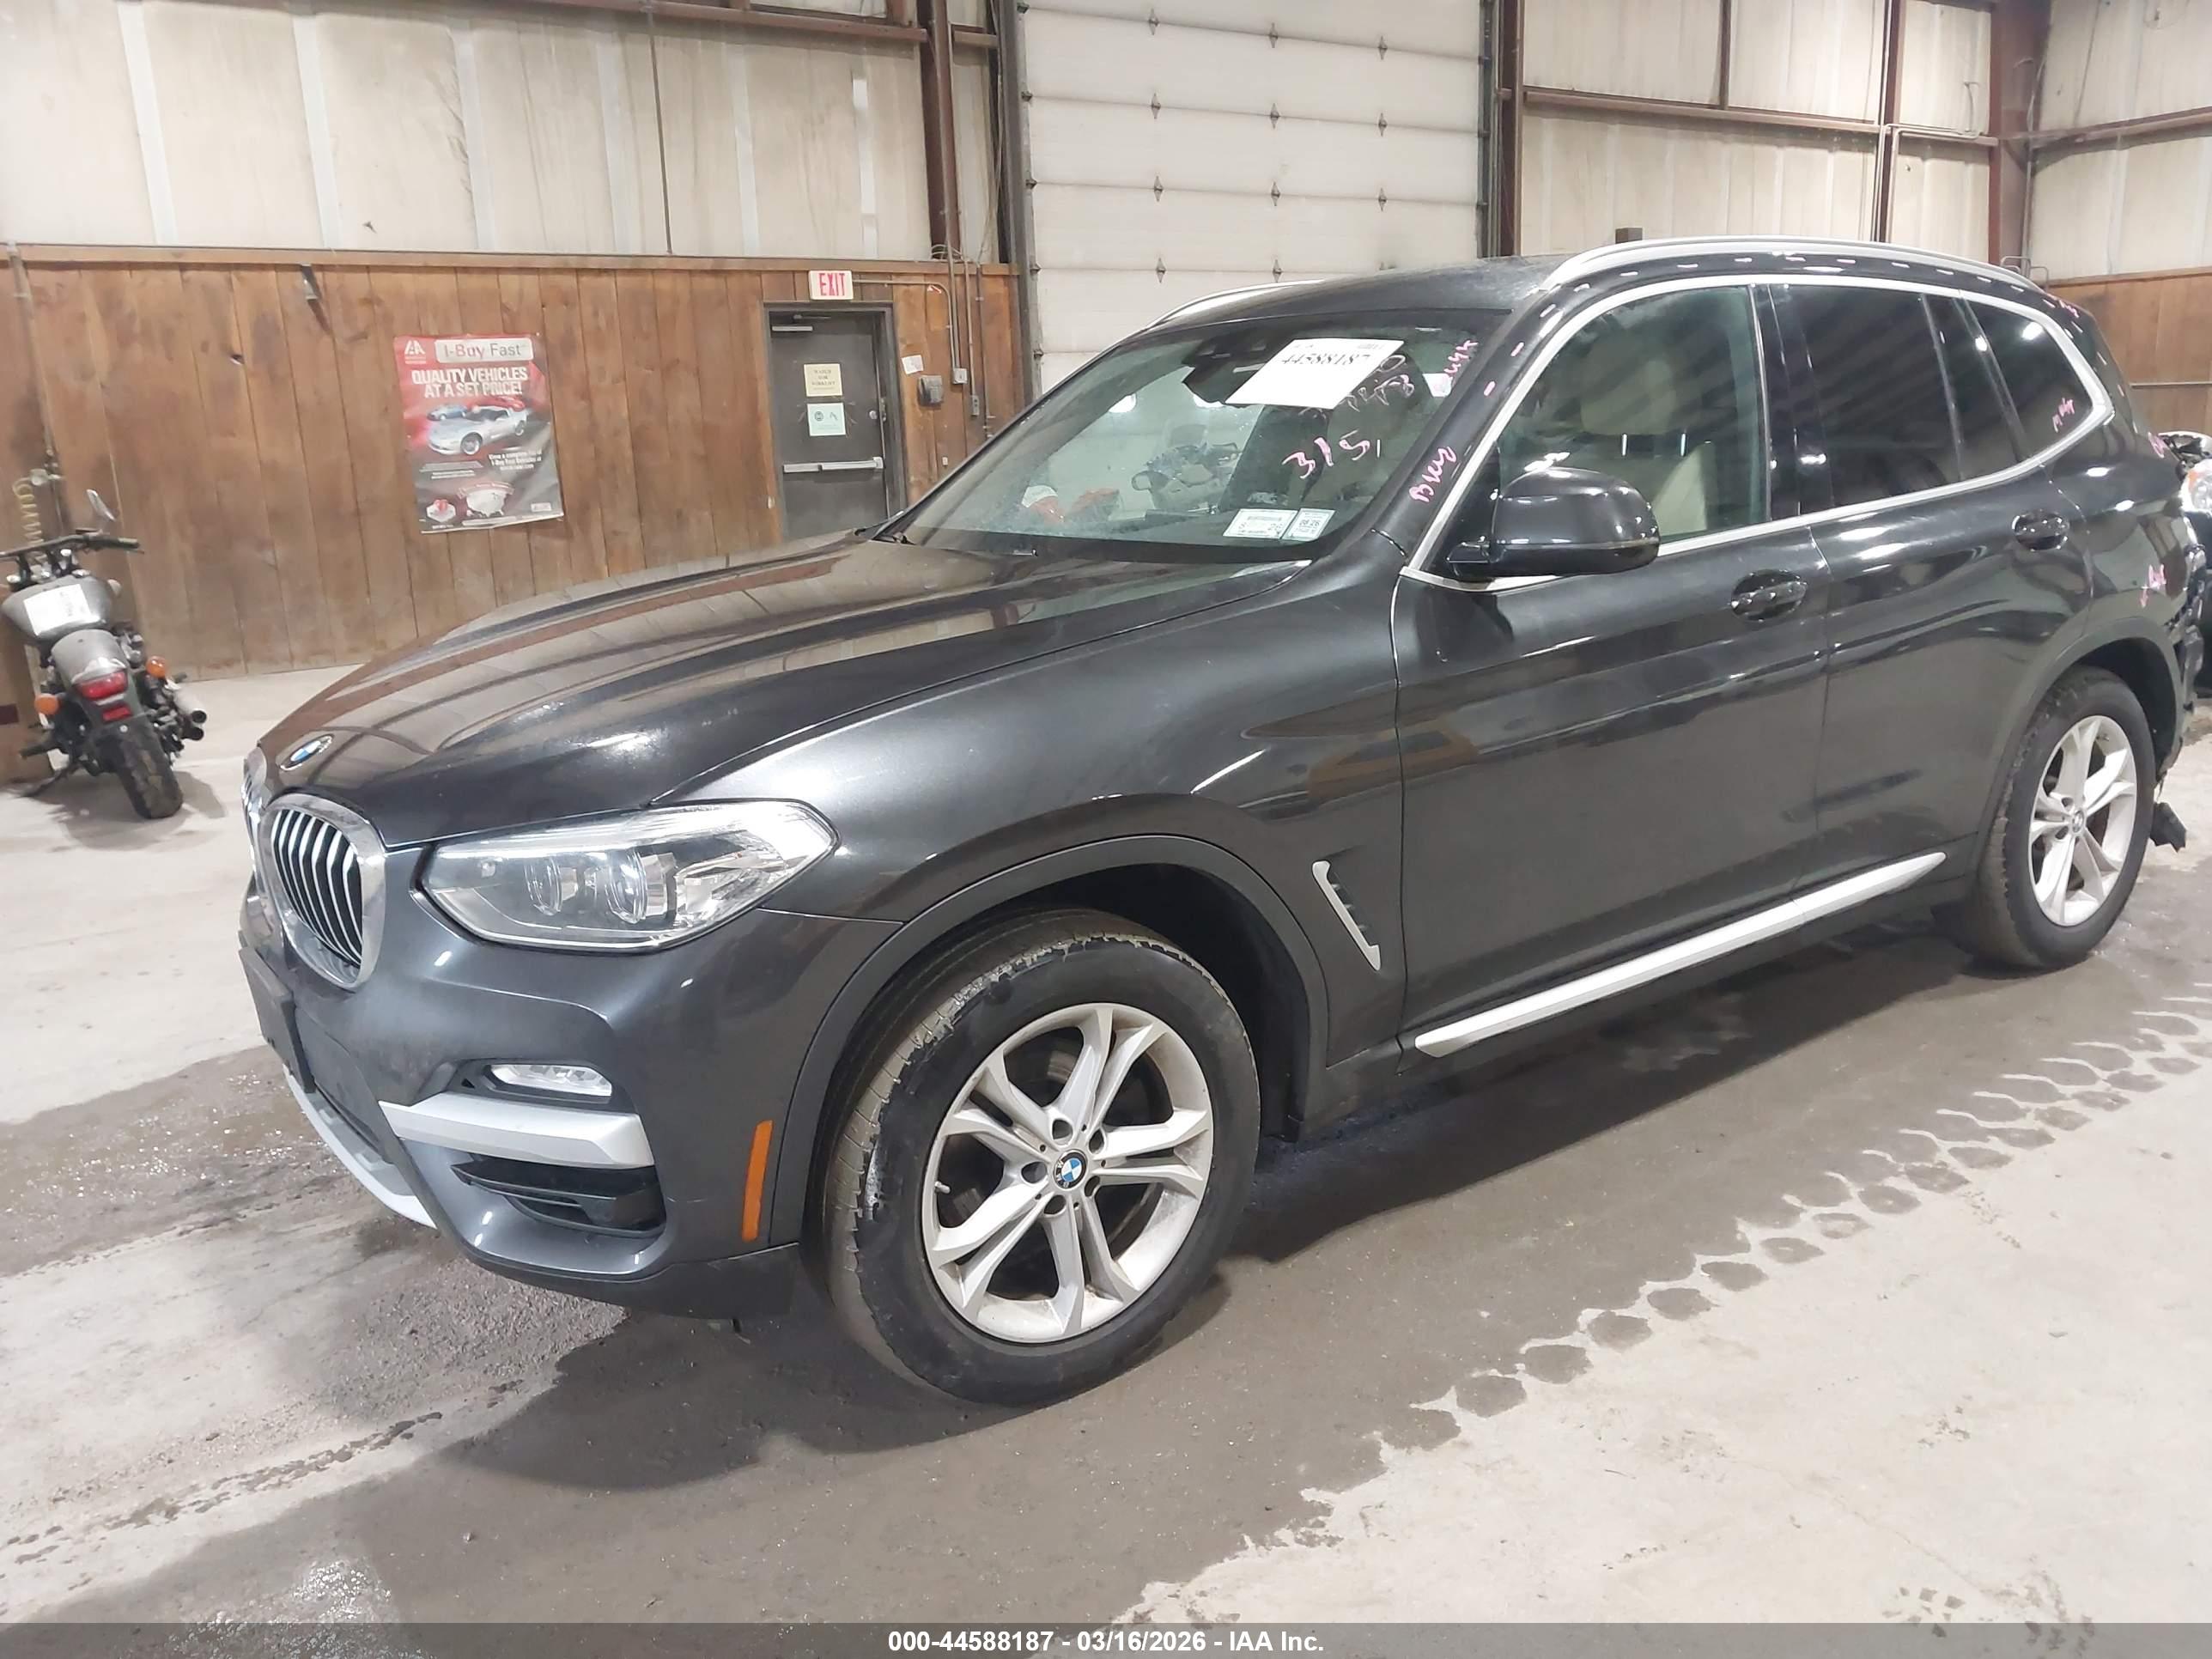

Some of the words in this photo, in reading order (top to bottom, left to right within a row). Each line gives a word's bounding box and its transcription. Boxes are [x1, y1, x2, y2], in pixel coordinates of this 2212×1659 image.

[819, 272, 845, 296] EXIT
[444, 344, 484, 358] I-Buy
[1280, 353, 1371, 366] 44588187
[411, 368, 466, 384] QUALITY
[468, 367, 529, 381] VEHICLES
[424, 384, 441, 398] AT
[444, 383, 455, 398] A
[456, 383, 481, 397] SET
[482, 381, 523, 396] PRICE!
